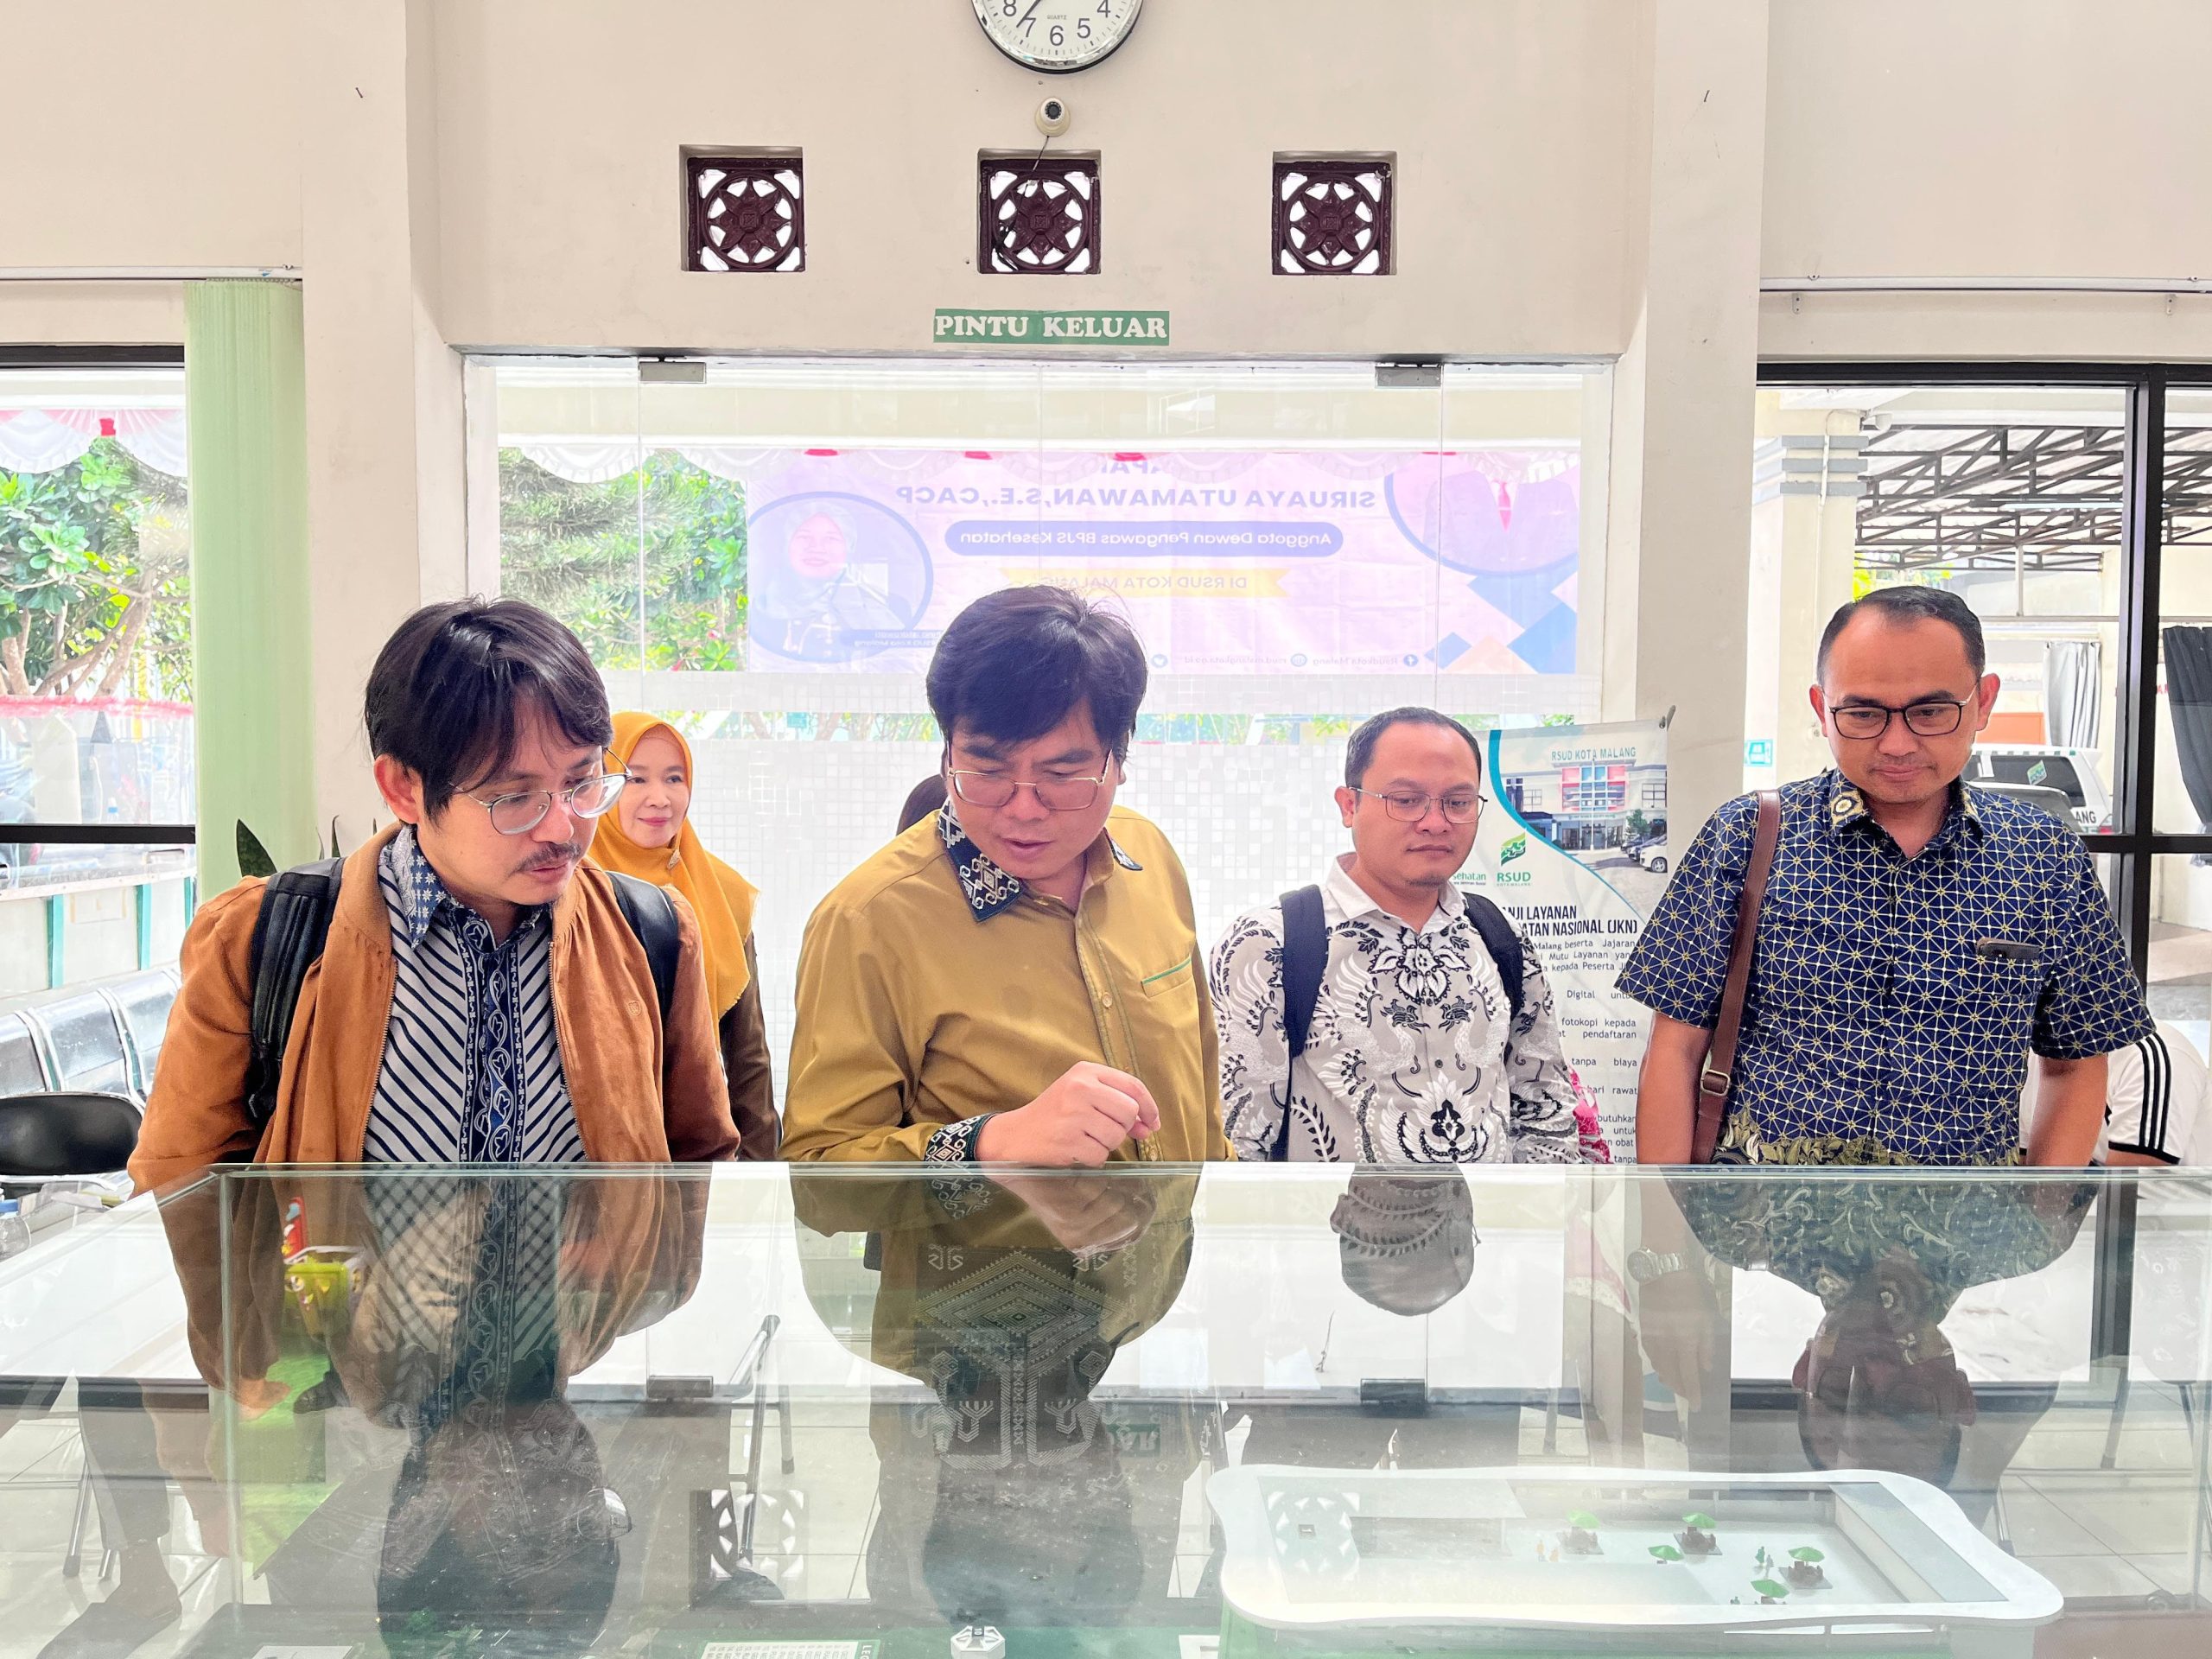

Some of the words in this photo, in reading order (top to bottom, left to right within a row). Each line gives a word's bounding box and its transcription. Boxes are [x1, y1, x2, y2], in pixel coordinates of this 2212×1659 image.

[1002, 0, 1017, 17] 8
[1096, 0, 1111, 18] 4
[1022, 17, 1037, 38] 7
[1077, 17, 1091, 39] 5
[1049, 25, 1065, 47] 6
[935, 315, 1029, 336] PINTU
[1042, 316, 1167, 338] KELUAR
[1551, 751, 1573, 761] RSUD
[1575, 749, 1597, 760] KOTA
[1600, 747, 1637, 759] MALANG
[2074, 810, 2097, 823] ANG
[1497, 872, 1531, 882] RSUD
[1526, 906, 1577, 920] LAYANAN
[1522, 922, 1549, 937] ATAN
[1553, 919, 1605, 937] NASIONAL
[1608, 919, 1637, 934] (JKN)
[1565, 939, 1593, 949] beserta
[1602, 939, 1636, 950] Jajaran
[1573, 951, 1609, 960] Layanan
[1552, 963, 1579, 972] kepada
[1582, 962, 1615, 971] Peserta
[1567, 989, 1596, 1001] Digital
[1611, 991, 1632, 1000] untu
[1561, 1018, 1598, 1028] fotokopi
[1605, 1018, 1637, 1029] kepada
[1582, 1030, 1637, 1039] pendaftaran
[1571, 1058, 1597, 1066] tanpa
[1613, 1058, 1637, 1067] biaya
[1615, 1138, 1634, 1147] obat
[1614, 1155, 1637, 1165] tanpa
